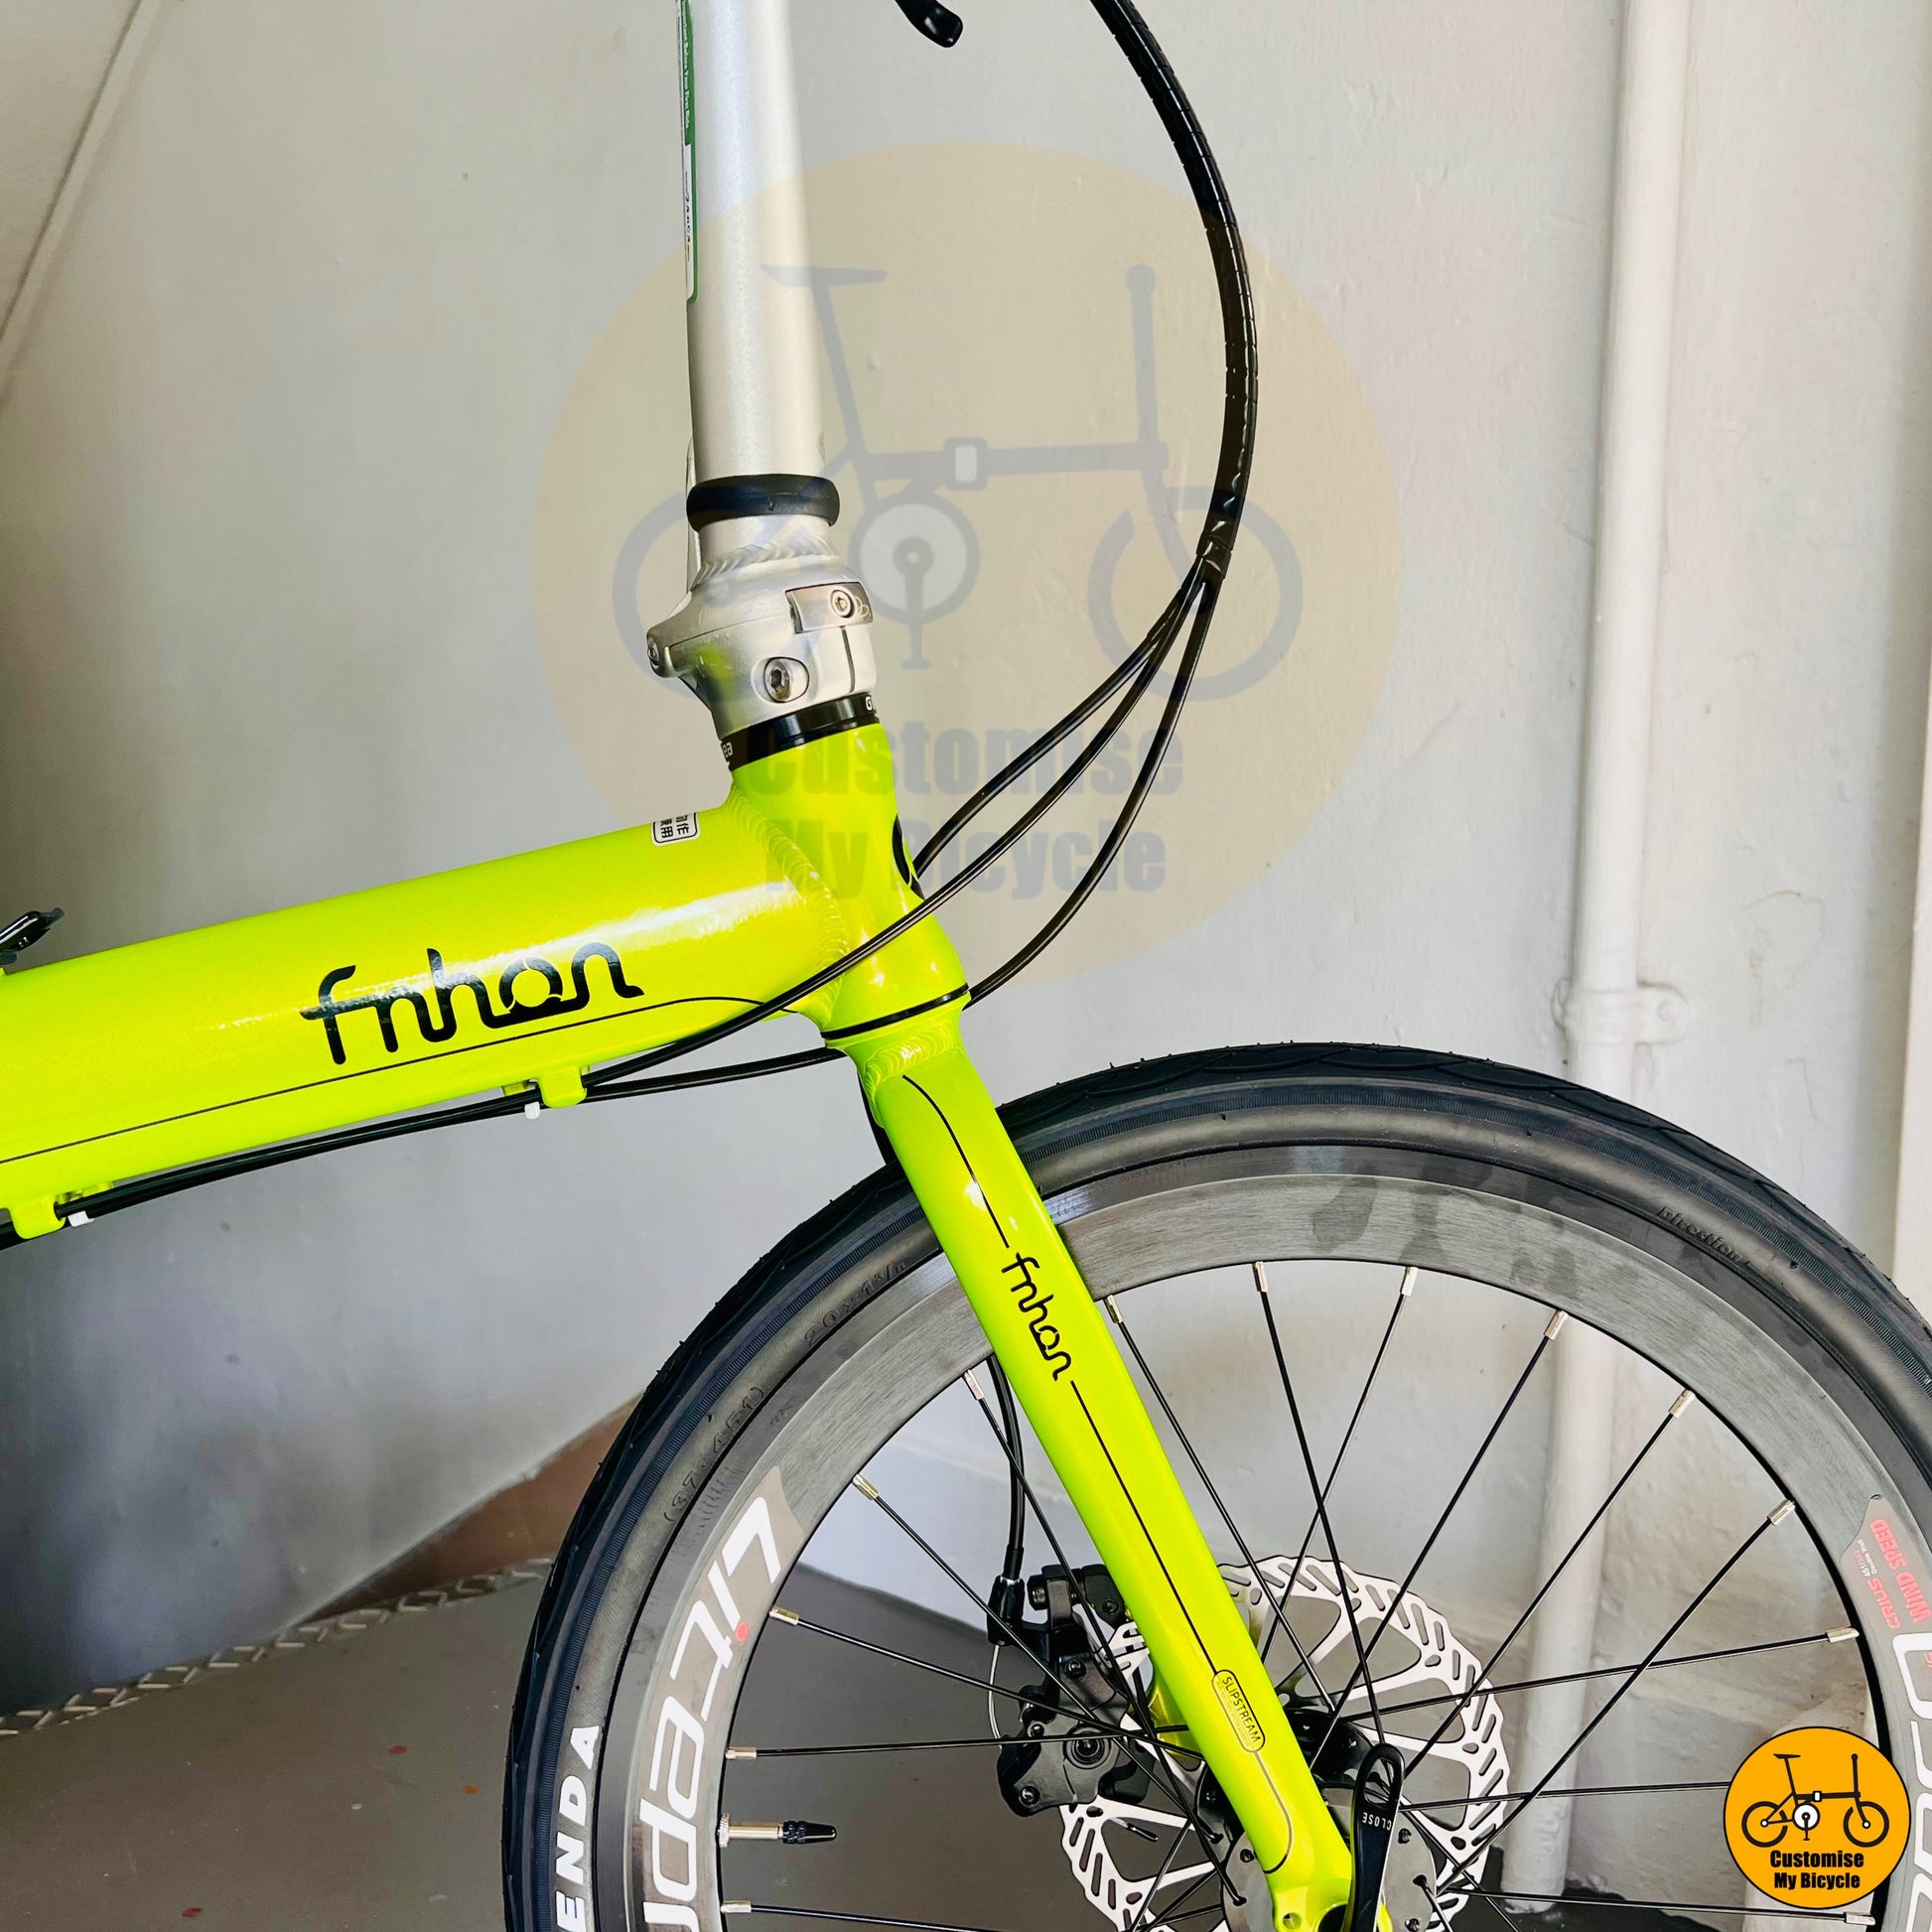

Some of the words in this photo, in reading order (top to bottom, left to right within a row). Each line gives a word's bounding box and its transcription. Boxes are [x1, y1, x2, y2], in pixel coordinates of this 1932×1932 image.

[1870, 1518, 1907, 1571] SPEED
[1867, 1578, 1901, 1629] CRIUS
[1896, 1572, 1932, 1624] WIND
[1222, 1676, 1261, 1742] SLIPSTREAM
[1361, 1812, 1392, 1831] CLOSE
